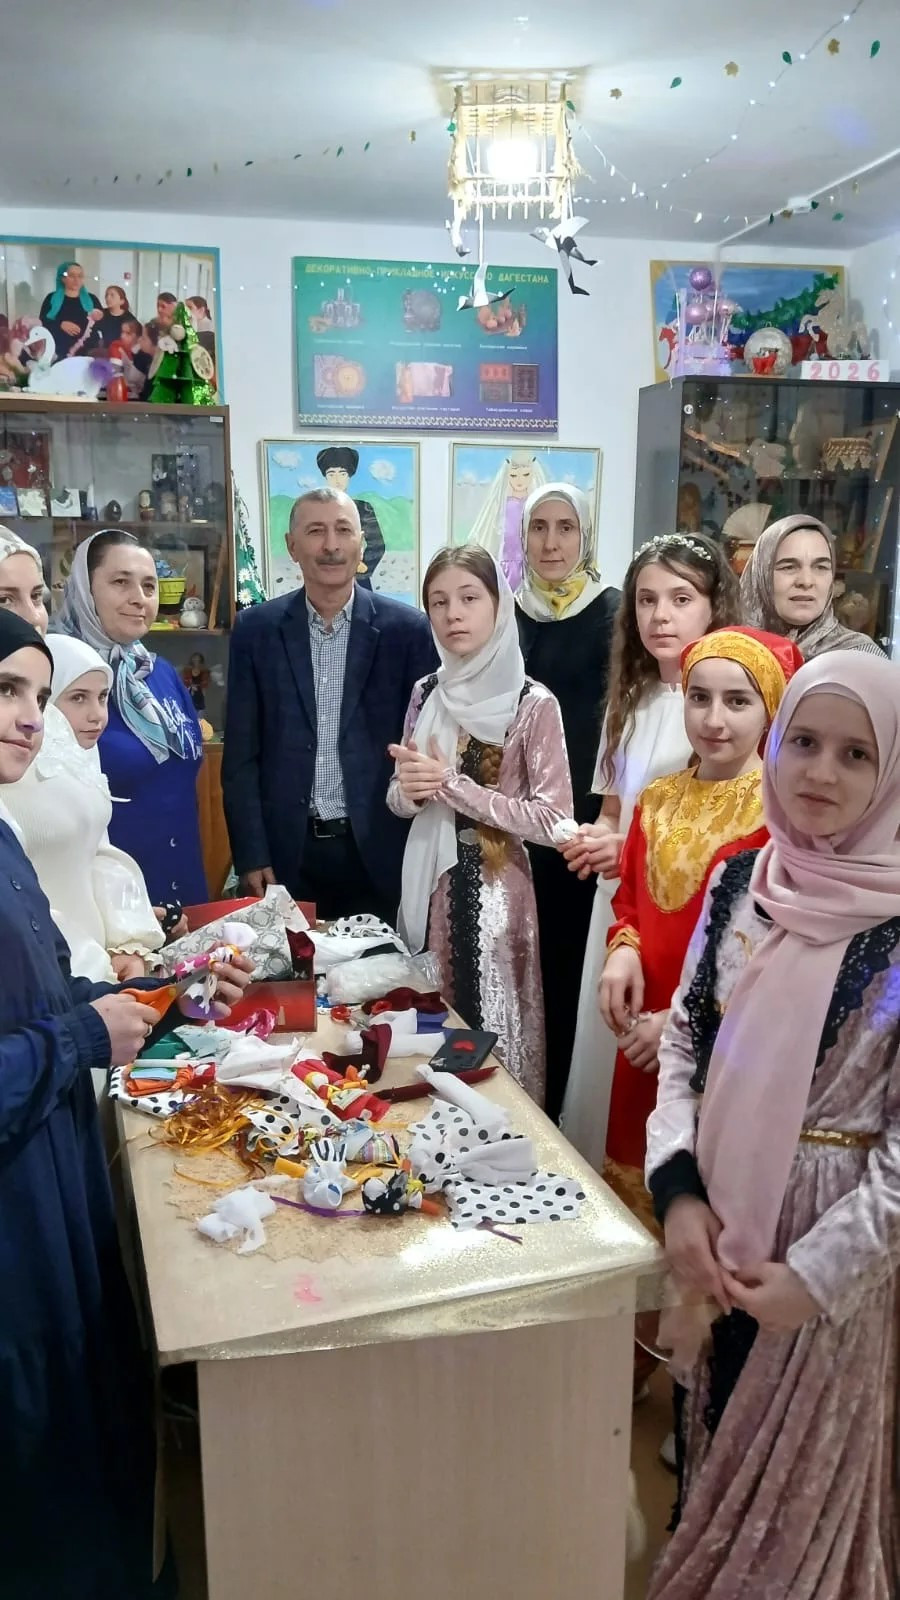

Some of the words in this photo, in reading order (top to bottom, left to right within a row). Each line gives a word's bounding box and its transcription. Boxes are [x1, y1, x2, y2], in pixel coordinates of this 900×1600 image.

[440, 270, 493, 281] ИКУССО
[498, 273, 550, 284] ДАГЕСТАНА
[810, 362, 880, 381] 2026
